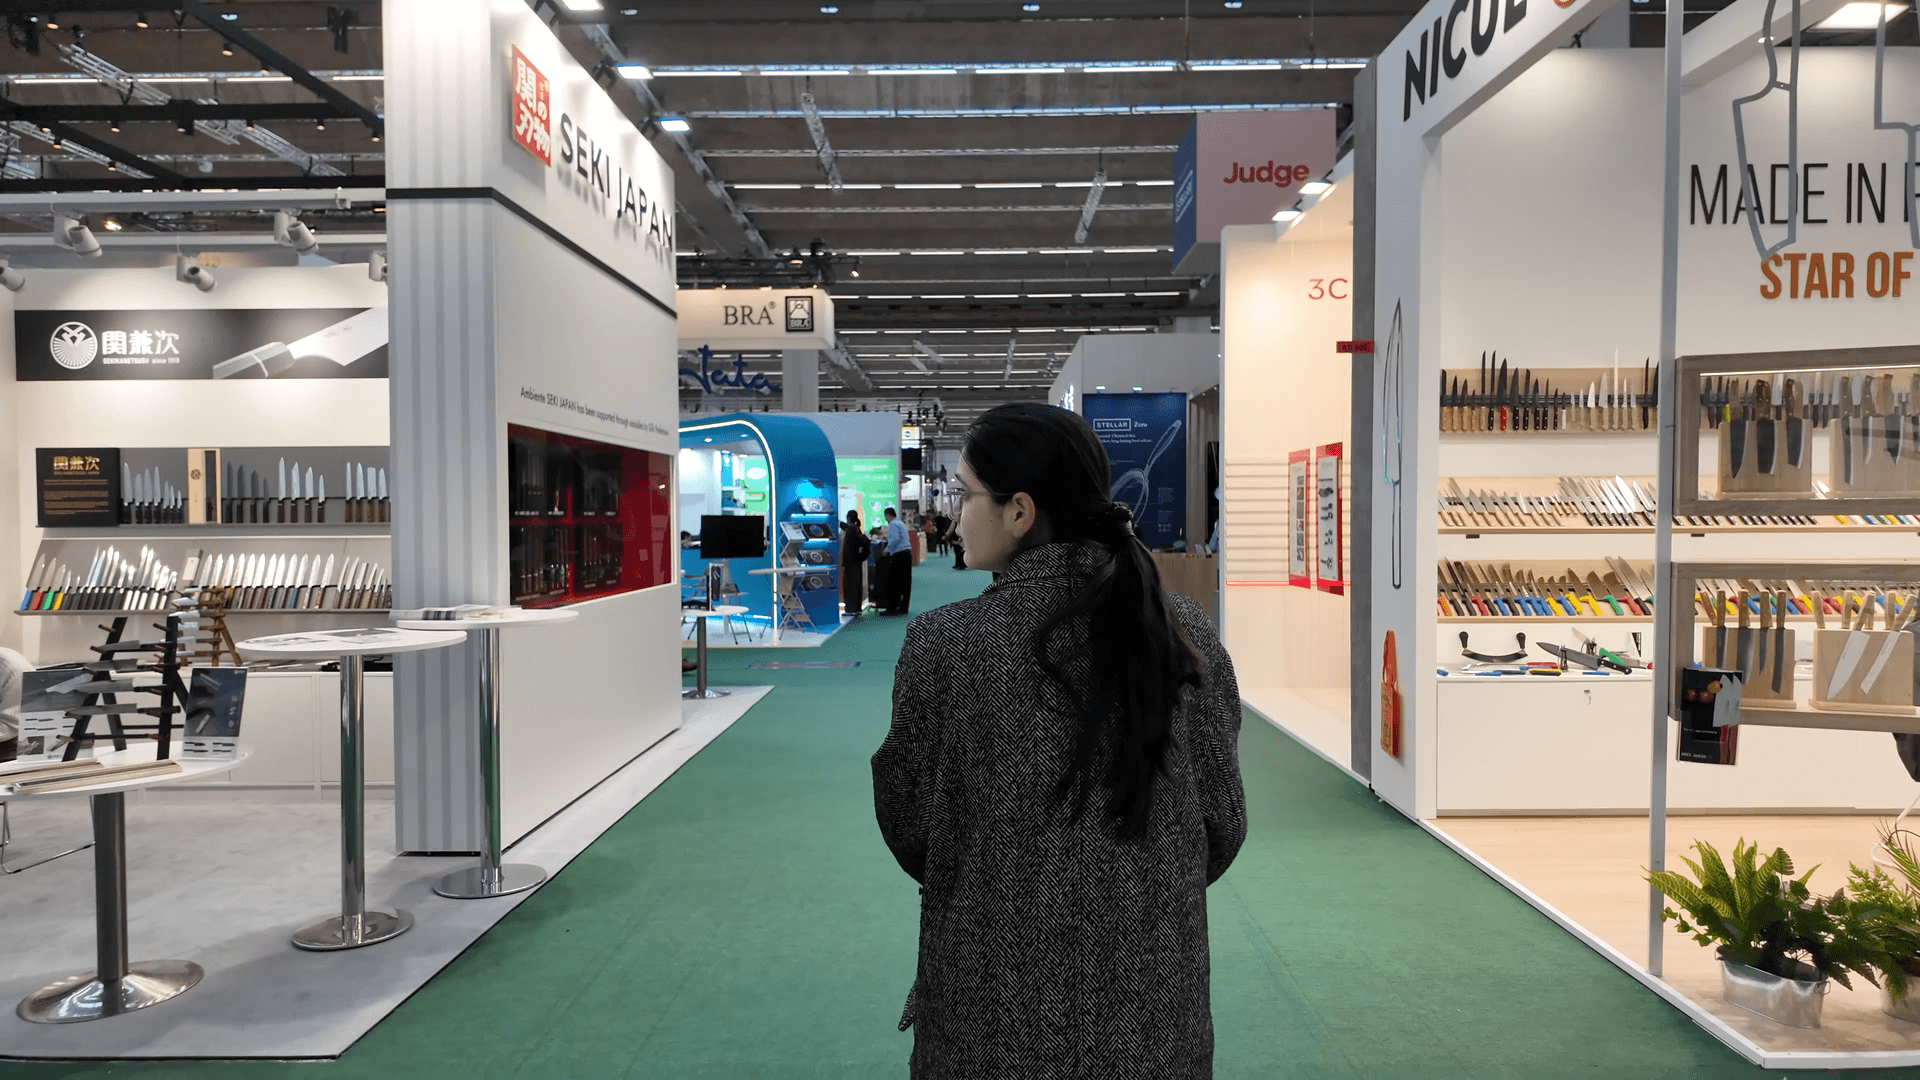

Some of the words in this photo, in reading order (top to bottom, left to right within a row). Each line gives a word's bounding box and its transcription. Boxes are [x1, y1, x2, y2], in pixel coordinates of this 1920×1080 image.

[560, 112, 610, 199] SEKI
[616, 166, 673, 253] JAPAN
[1223, 160, 1310, 188] Judge
[1689, 163, 1829, 225] MADE
[1846, 162, 1887, 224] IN
[1759, 251, 1855, 299] STAR
[1866, 251, 1914, 298] OF
[102, 330, 180, 355] 関兼次
[546, 393, 559, 407] SEKI
[559, 397, 577, 411] JAPAN
[1096, 421, 1129, 429] STELLAR
